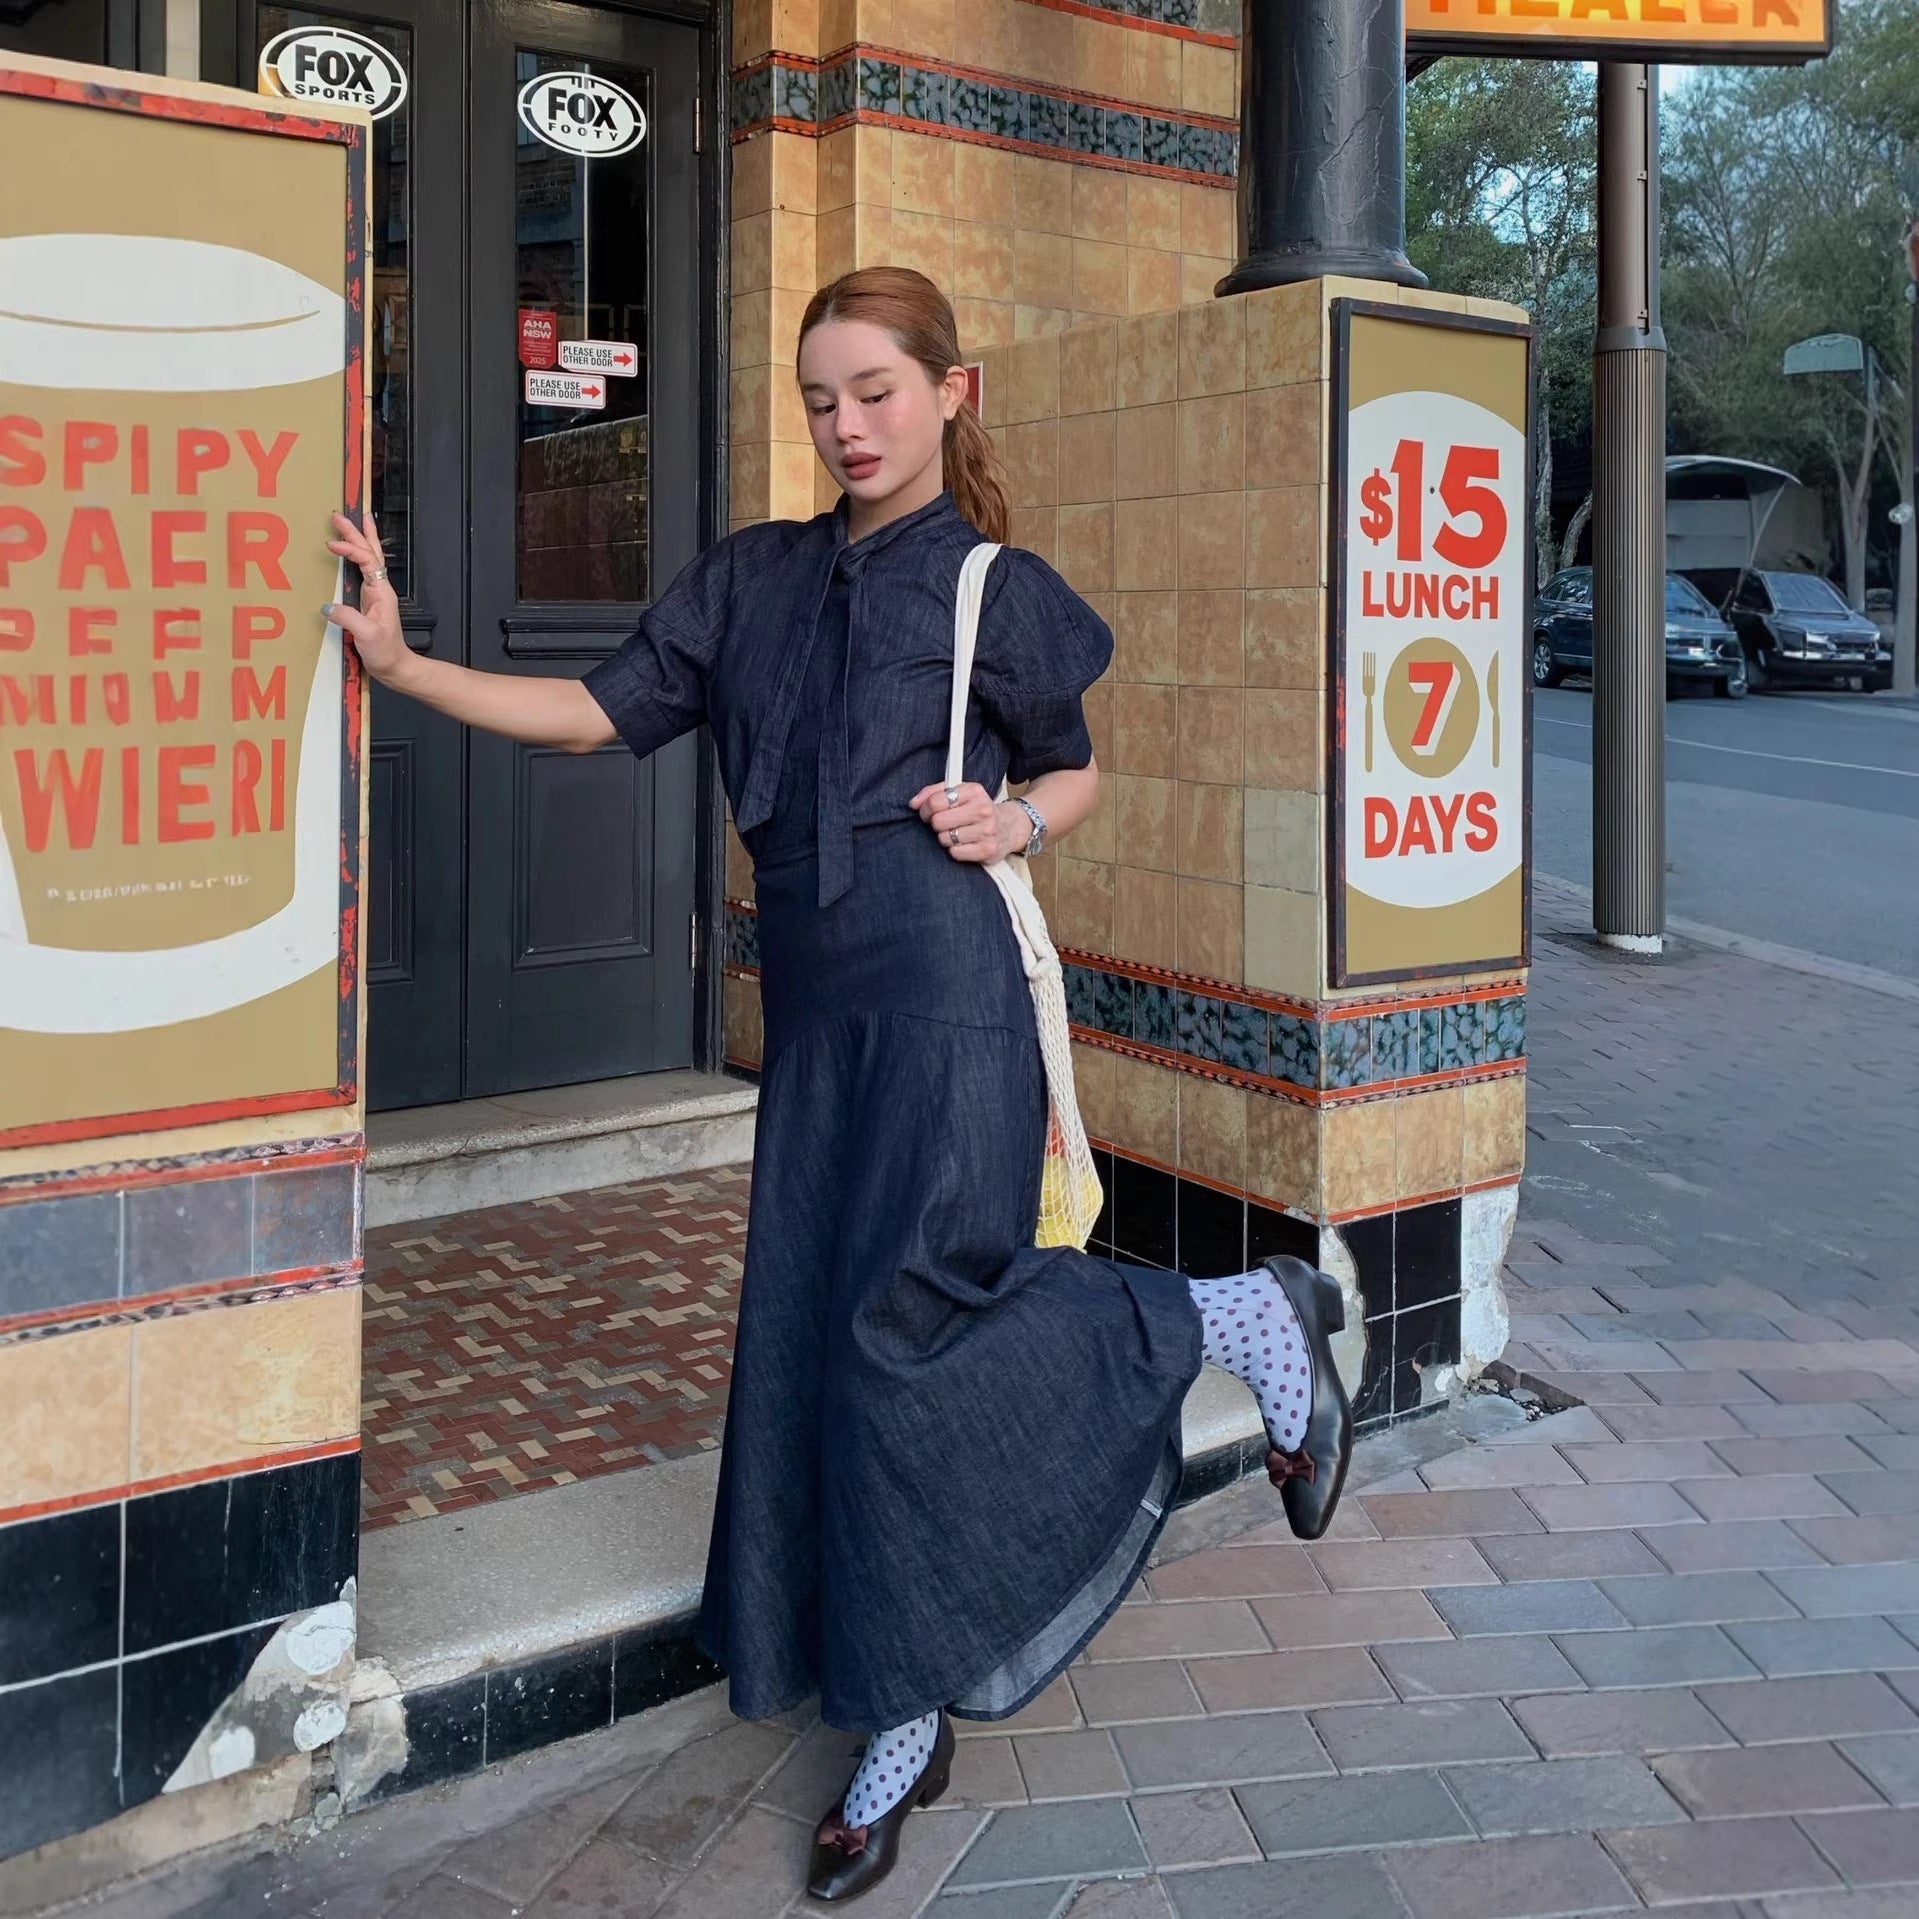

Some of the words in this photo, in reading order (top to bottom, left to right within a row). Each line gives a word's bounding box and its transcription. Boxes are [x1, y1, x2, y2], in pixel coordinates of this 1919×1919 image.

[295, 44, 375, 92] FOX
[295, 83, 376, 105] SPORTS
[548, 87, 618, 131] FOX
[548, 122, 618, 141] FOOTY
[523, 319, 552, 329] AHA
[523, 328, 552, 339] NSW
[529, 356, 547, 365] 2025
[563, 346, 593, 357] PLEASE
[596, 349, 613, 359] USE
[563, 355, 588, 365] OTHER
[590, 357, 613, 367] DOOR
[530, 378, 561, 389] PLEASE
[564, 381, 580, 391] USE
[530, 388, 556, 398] OTHER
[558, 390, 581, 399] DOOR
[1359, 438, 1508, 569] $15
[1362, 570, 1499, 620] LUNCH
[1408, 661, 1459, 756] 7
[1364, 791, 1498, 858] DAYS
